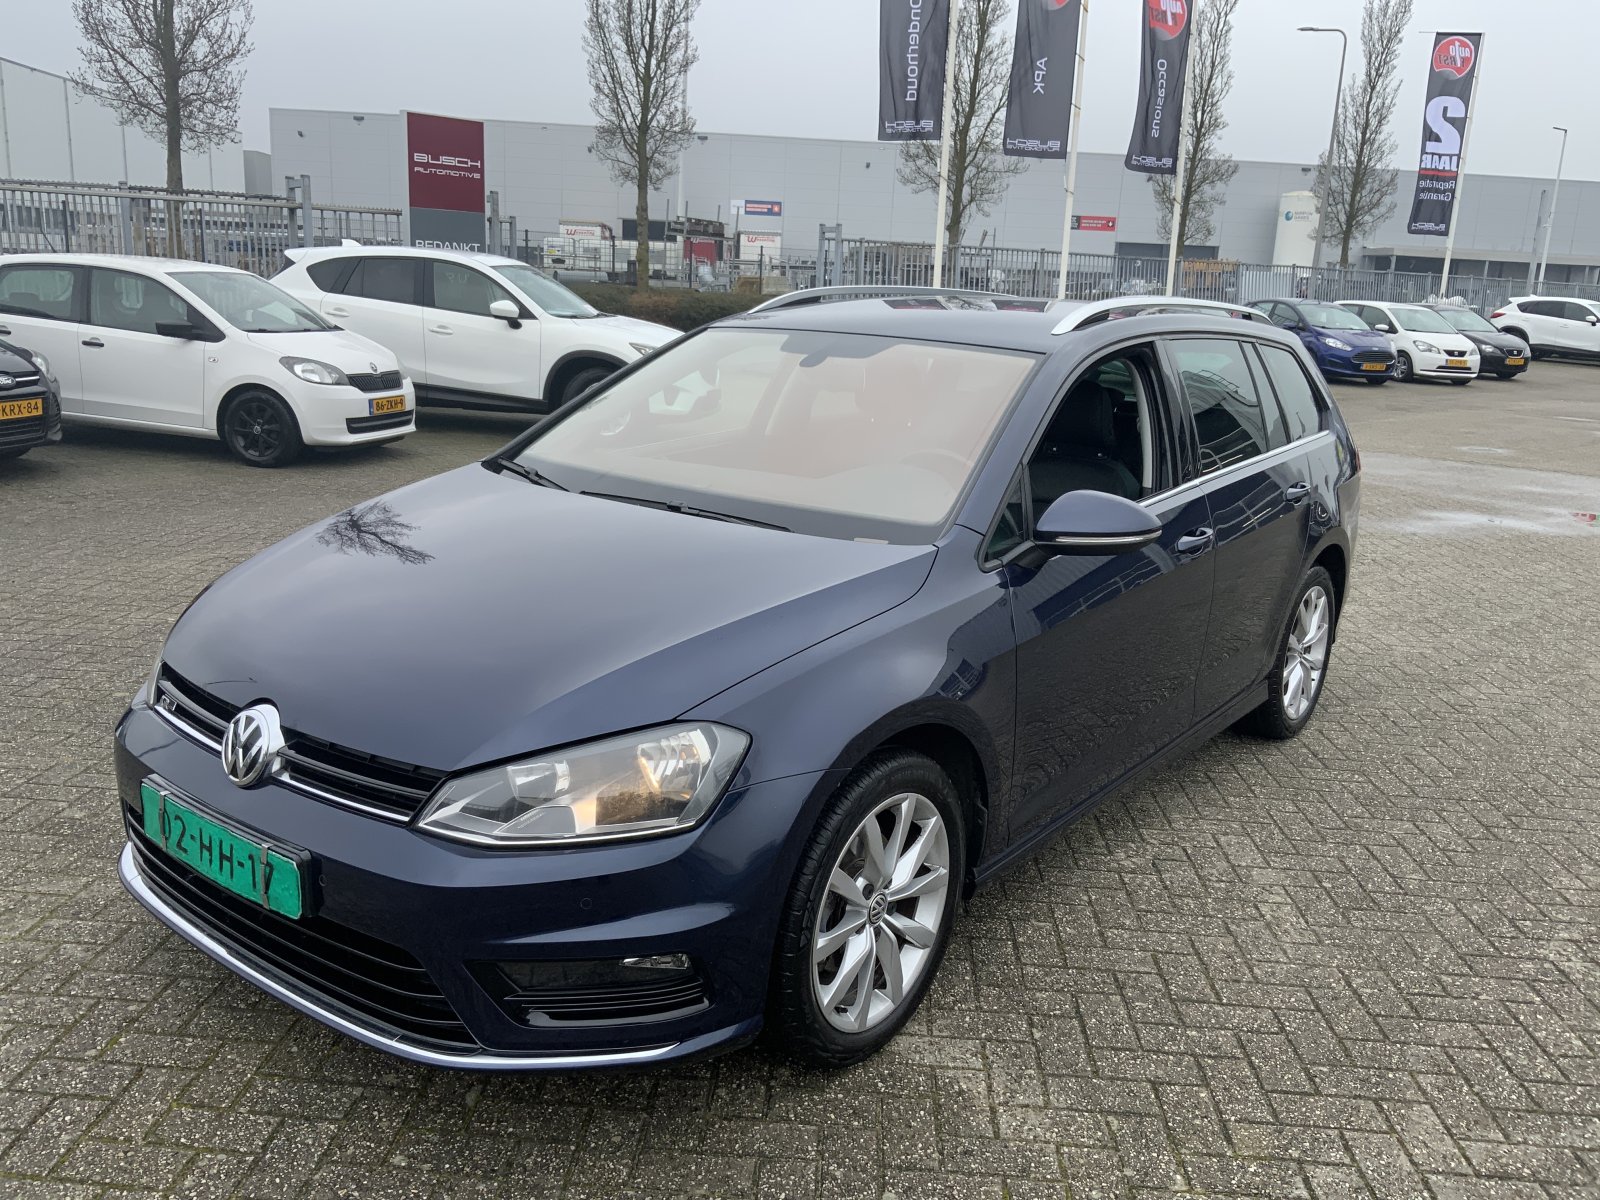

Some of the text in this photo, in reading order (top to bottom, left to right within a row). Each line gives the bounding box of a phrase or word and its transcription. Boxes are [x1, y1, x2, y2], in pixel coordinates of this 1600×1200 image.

[413, 152, 481, 169] BUSCH
[414, 166, 481, 179] AUTOMOTIVE
[375, 398, 404, 412] 86-ZKH-9
